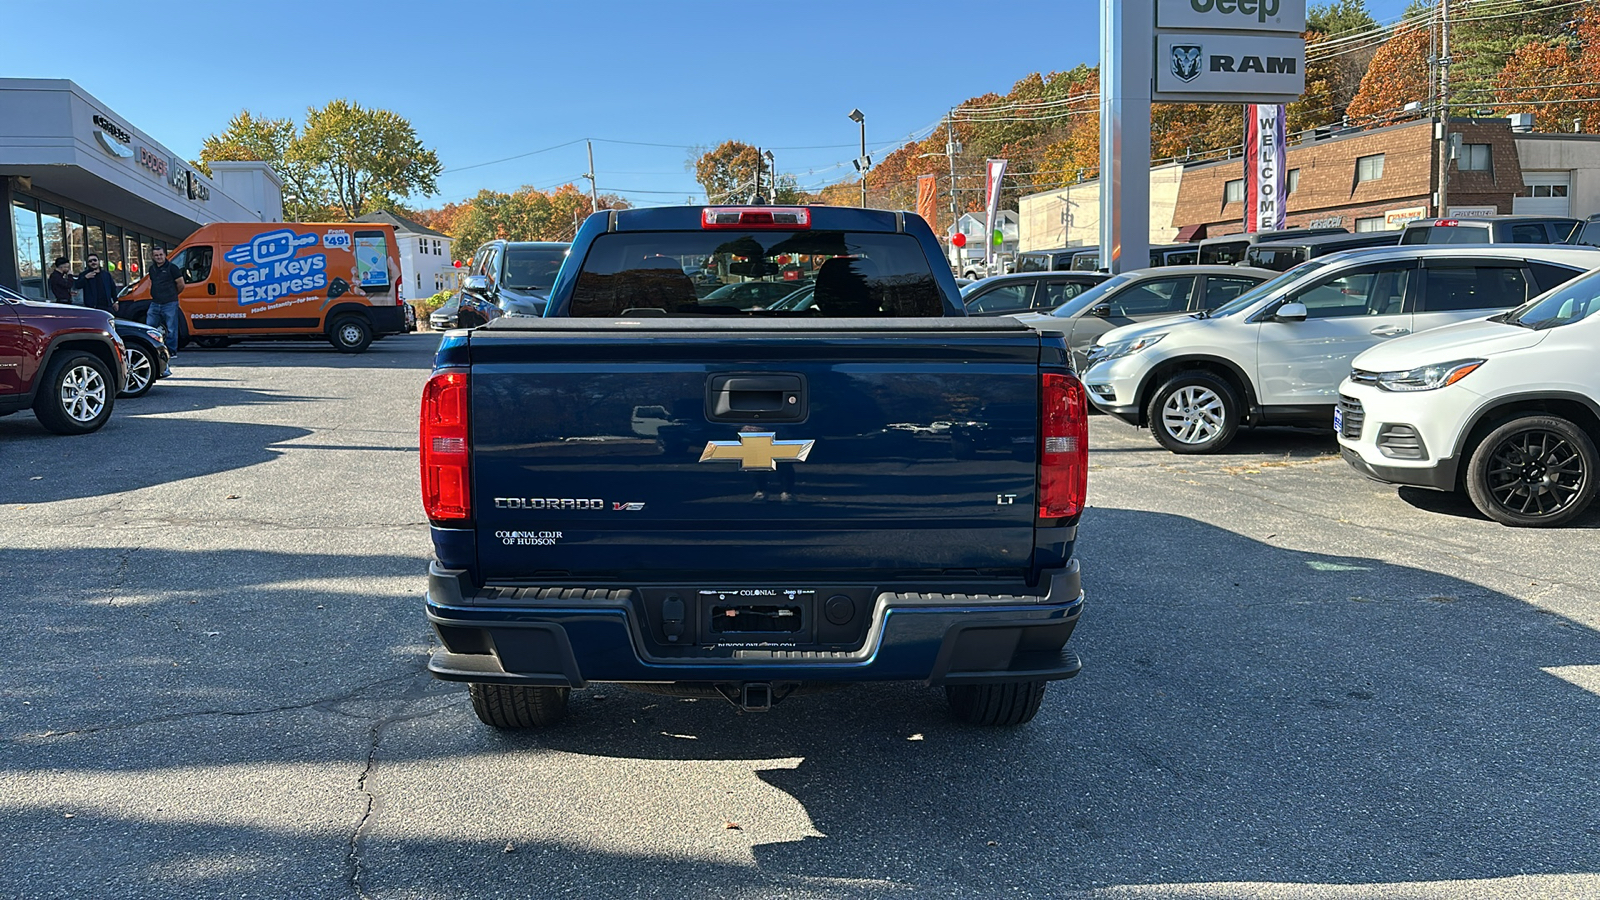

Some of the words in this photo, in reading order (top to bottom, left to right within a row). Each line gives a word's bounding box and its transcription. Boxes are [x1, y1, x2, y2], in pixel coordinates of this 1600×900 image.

[1210, 55, 1296, 74] RAM
[141, 146, 168, 177] DODGE
[1260, 117, 1276, 229] WELCOME
[325, 236, 349, 246] $49!
[232, 267, 269, 286] Car
[274, 256, 324, 278] Keys
[241, 274, 325, 303] Express
[251, 306, 267, 314] Made
[494, 497, 604, 510] COLORADO
[612, 502, 646, 511] V6
[997, 494, 1017, 504] LT
[495, 530, 537, 539] COLONIAL
[538, 530, 563, 540] CDJR
[502, 538, 515, 546] OF
[517, 538, 556, 546] HUDSON
